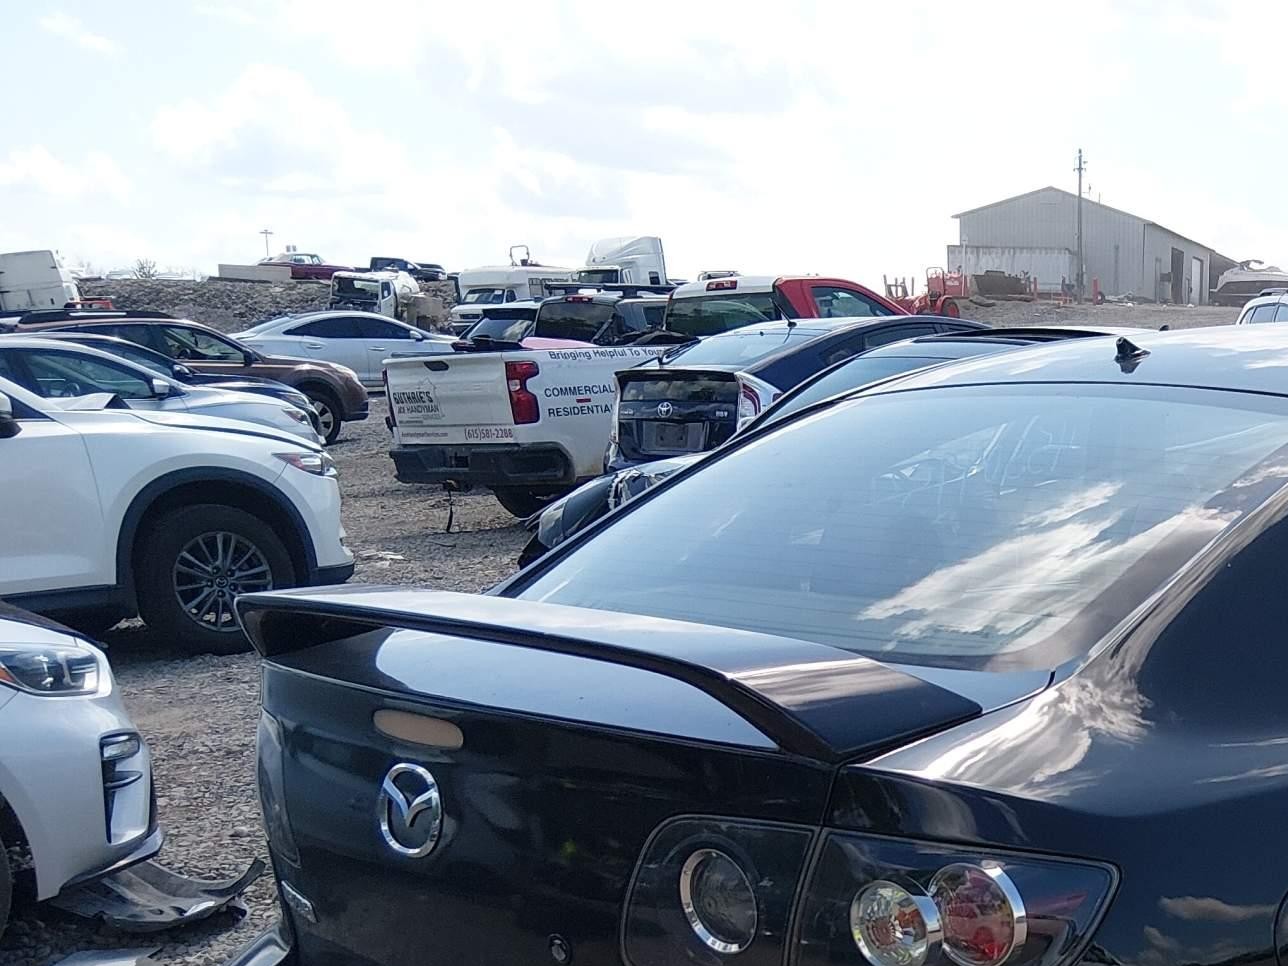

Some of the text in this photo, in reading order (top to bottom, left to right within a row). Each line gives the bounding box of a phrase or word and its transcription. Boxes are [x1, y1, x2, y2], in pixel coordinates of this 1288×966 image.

[549, 350, 591, 361] Bringing
[592, 348, 627, 359] Helpful
[628, 348, 641, 357] To
[392, 390, 434, 405] GUTHRIE'S
[544, 383, 615, 398] COMMERCIAL
